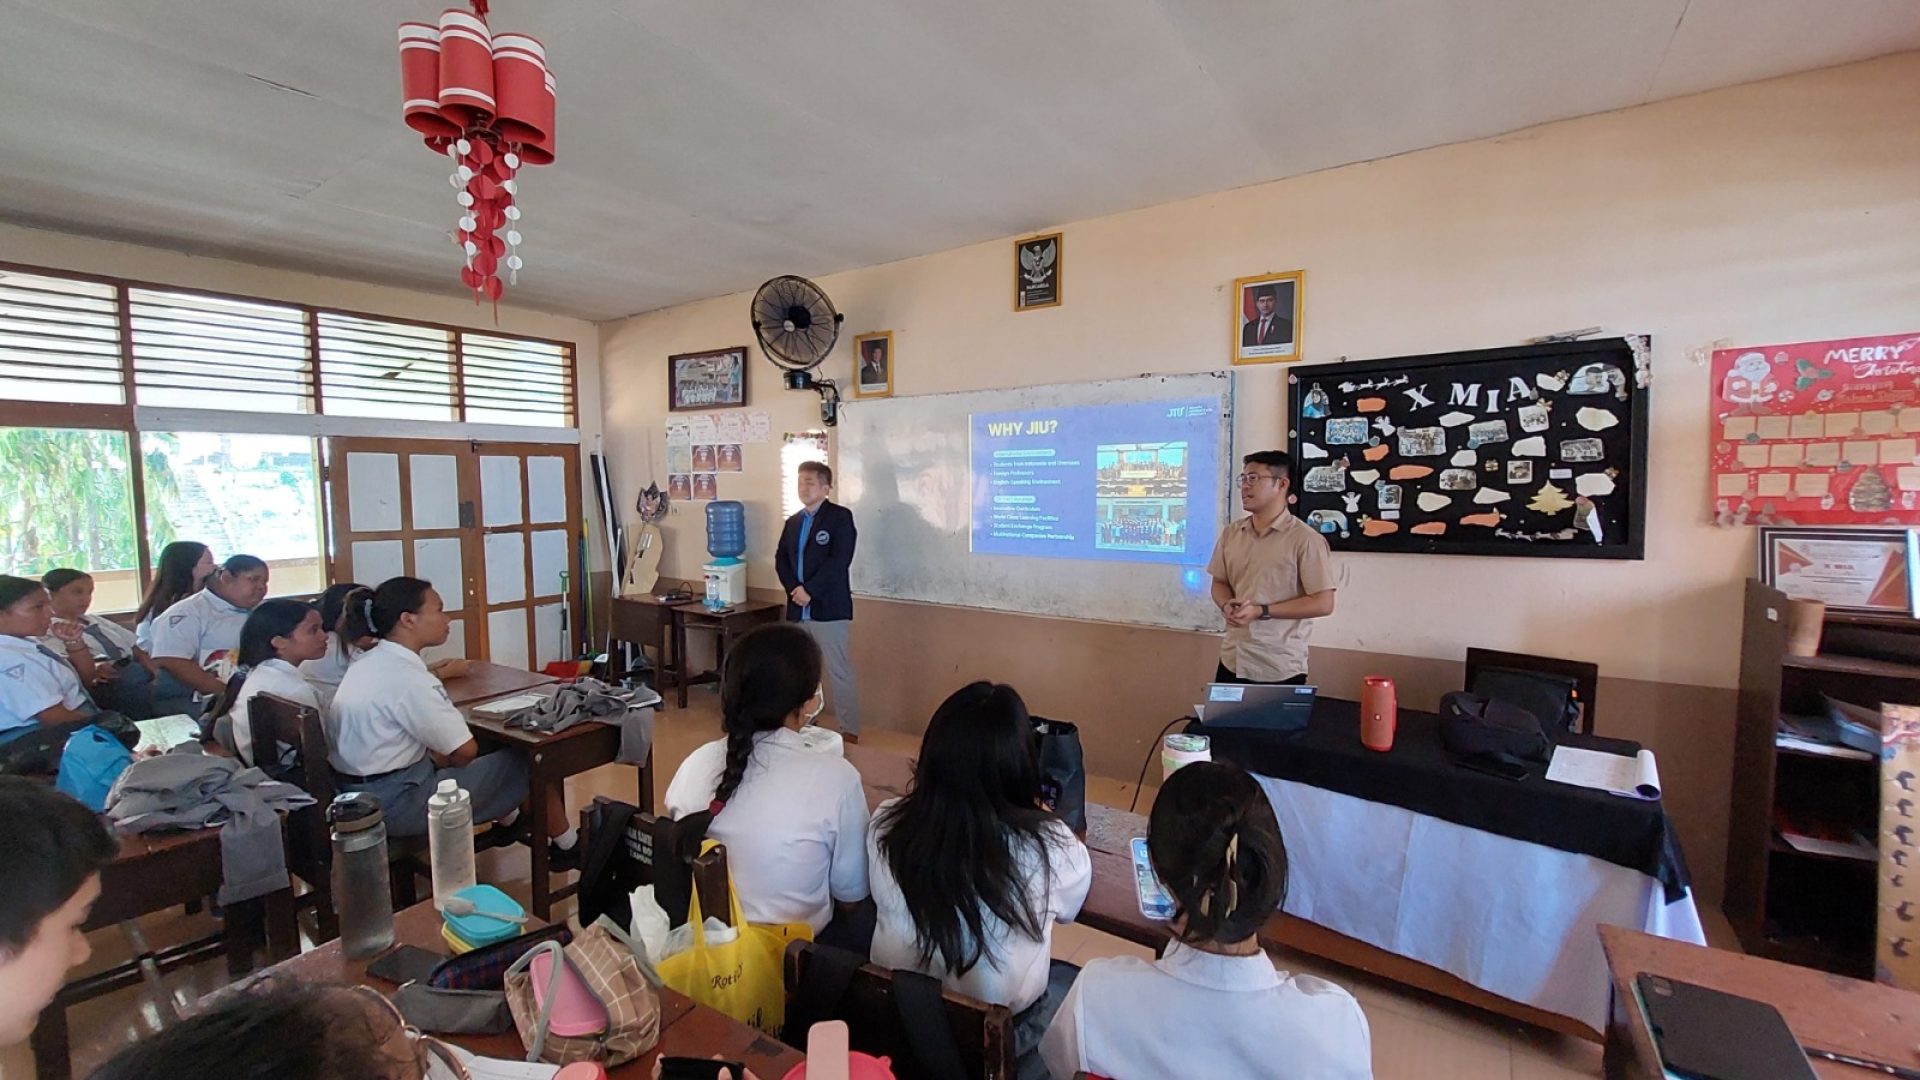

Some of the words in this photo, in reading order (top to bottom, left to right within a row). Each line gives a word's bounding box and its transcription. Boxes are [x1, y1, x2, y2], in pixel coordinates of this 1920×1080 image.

[1823, 345, 1903, 364] MERRY
[1402, 384, 1436, 412] X
[1447, 377, 1532, 413] MIA
[988, 421, 1023, 438] WHY
[1025, 419, 1058, 436] JIU?
